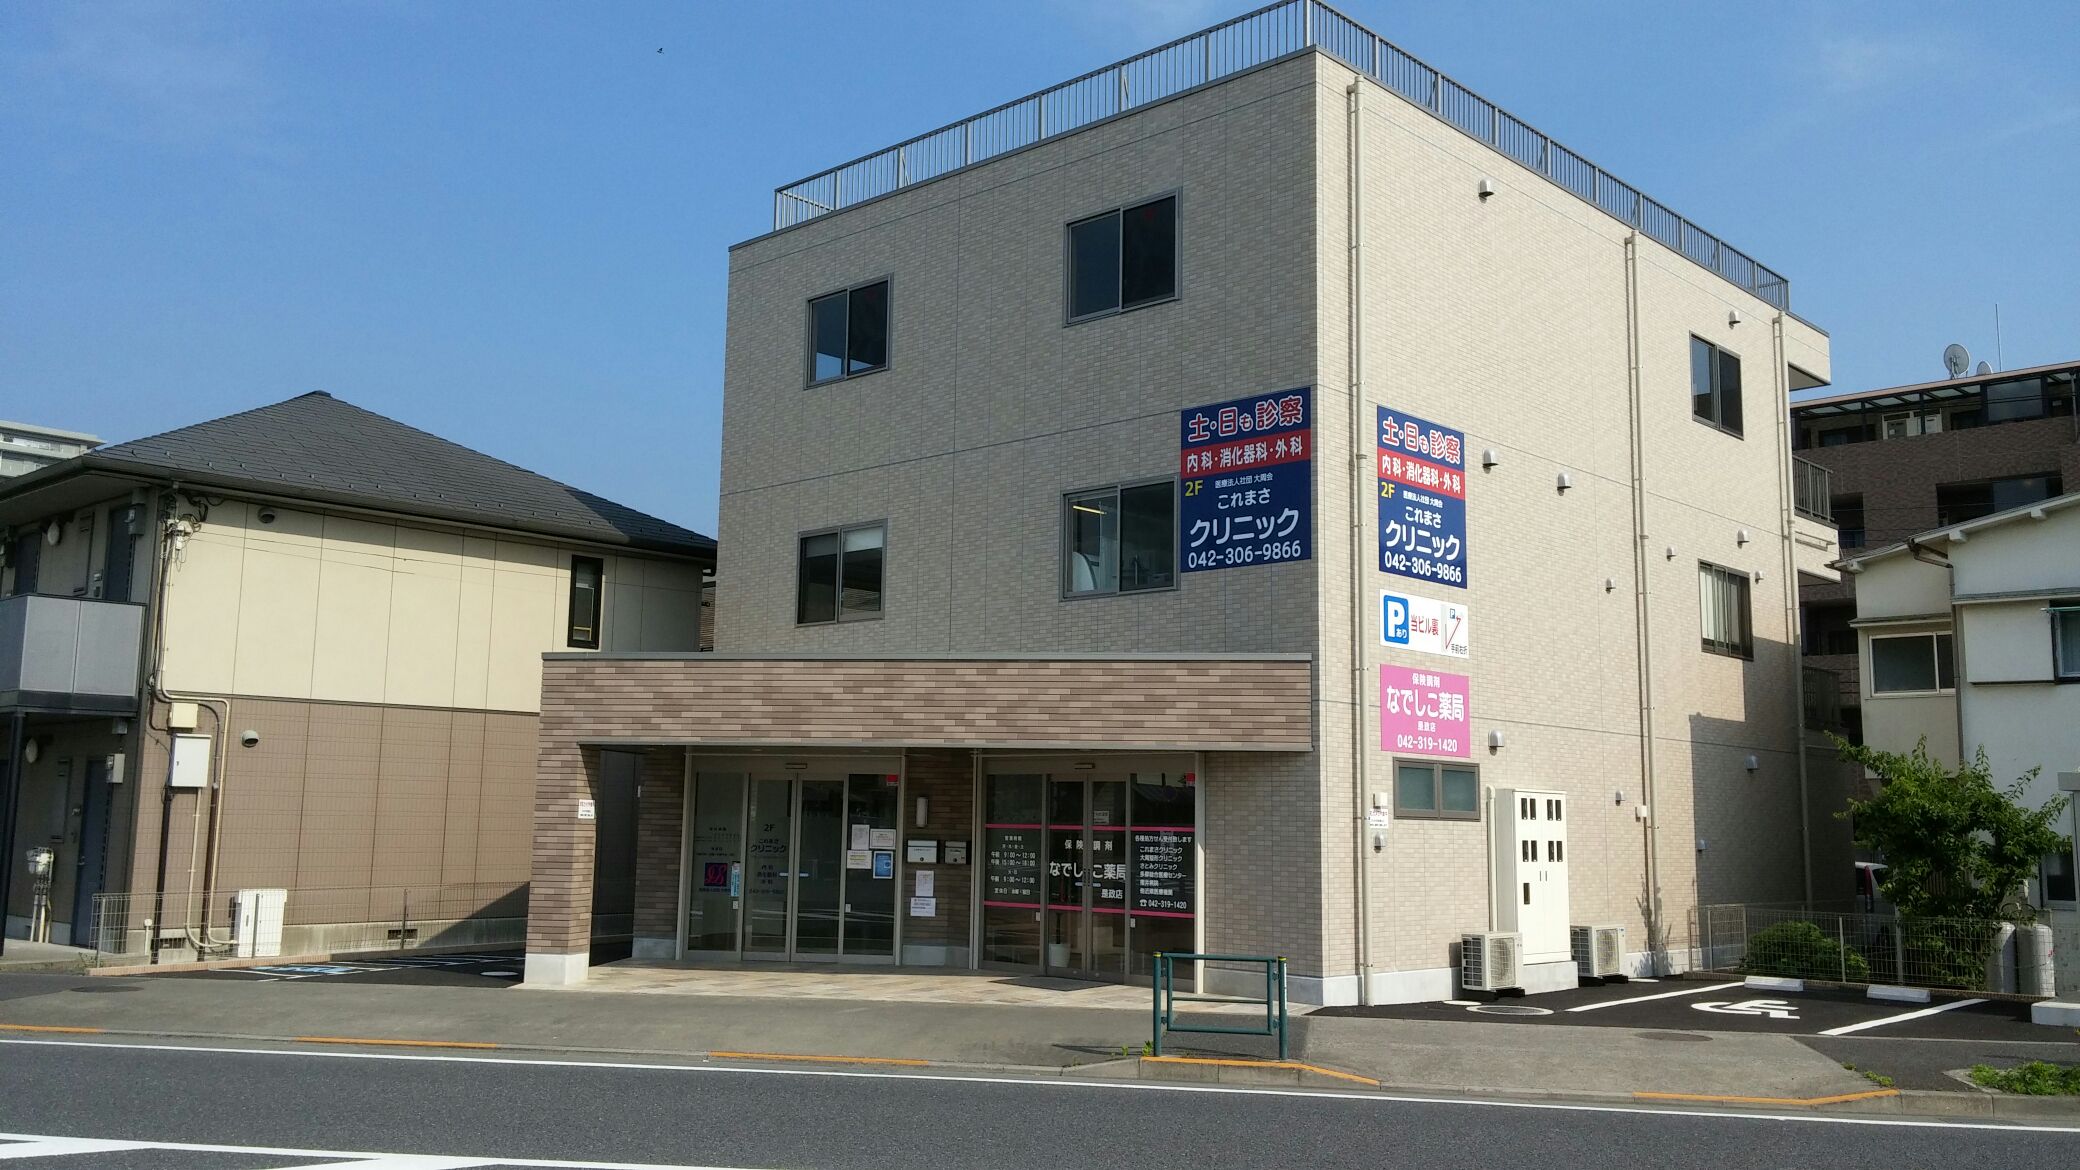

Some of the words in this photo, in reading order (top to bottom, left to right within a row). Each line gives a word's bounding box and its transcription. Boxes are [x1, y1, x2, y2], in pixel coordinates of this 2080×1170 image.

[1188, 395, 1302, 442] 土・日も診察
[1382, 416, 1461, 465] 土・日も診察
[1187, 435, 1303, 474] 内科・消化器科・外科
[1215, 475, 1253, 489] 医療法人社団
[1382, 454, 1461, 494] 内科・消化器科・外科
[1185, 480, 1204, 496] 2F
[1381, 481, 1395, 498] 2F
[1218, 487, 1271, 509] これまさ
[1405, 505, 1442, 528] これまさ
[1190, 507, 1299, 548] クリニック
[1386, 520, 1460, 560] クリニック
[1188, 539, 1301, 568] 042-306-9866
[1384, 550, 1462, 582] 042-306-9866
[1387, 600, 1406, 637] P
[1396, 627, 1408, 639] あり
[1412, 673, 1440, 688] 保険調剤
[1386, 685, 1465, 722] なでしこ薬局
[1397, 734, 1458, 752] 042-319-1420
[763, 823, 776, 832] 2F
[750, 844, 787, 853] クリニック
[1064, 839, 1113, 851] 保険調剤
[1140, 845, 1183, 854] これまさクリニック
[1049, 861, 1127, 880] なでしこ薬局
[1101, 888, 1123, 899] 是政店
[1148, 899, 1187, 909] 042-319-1420
